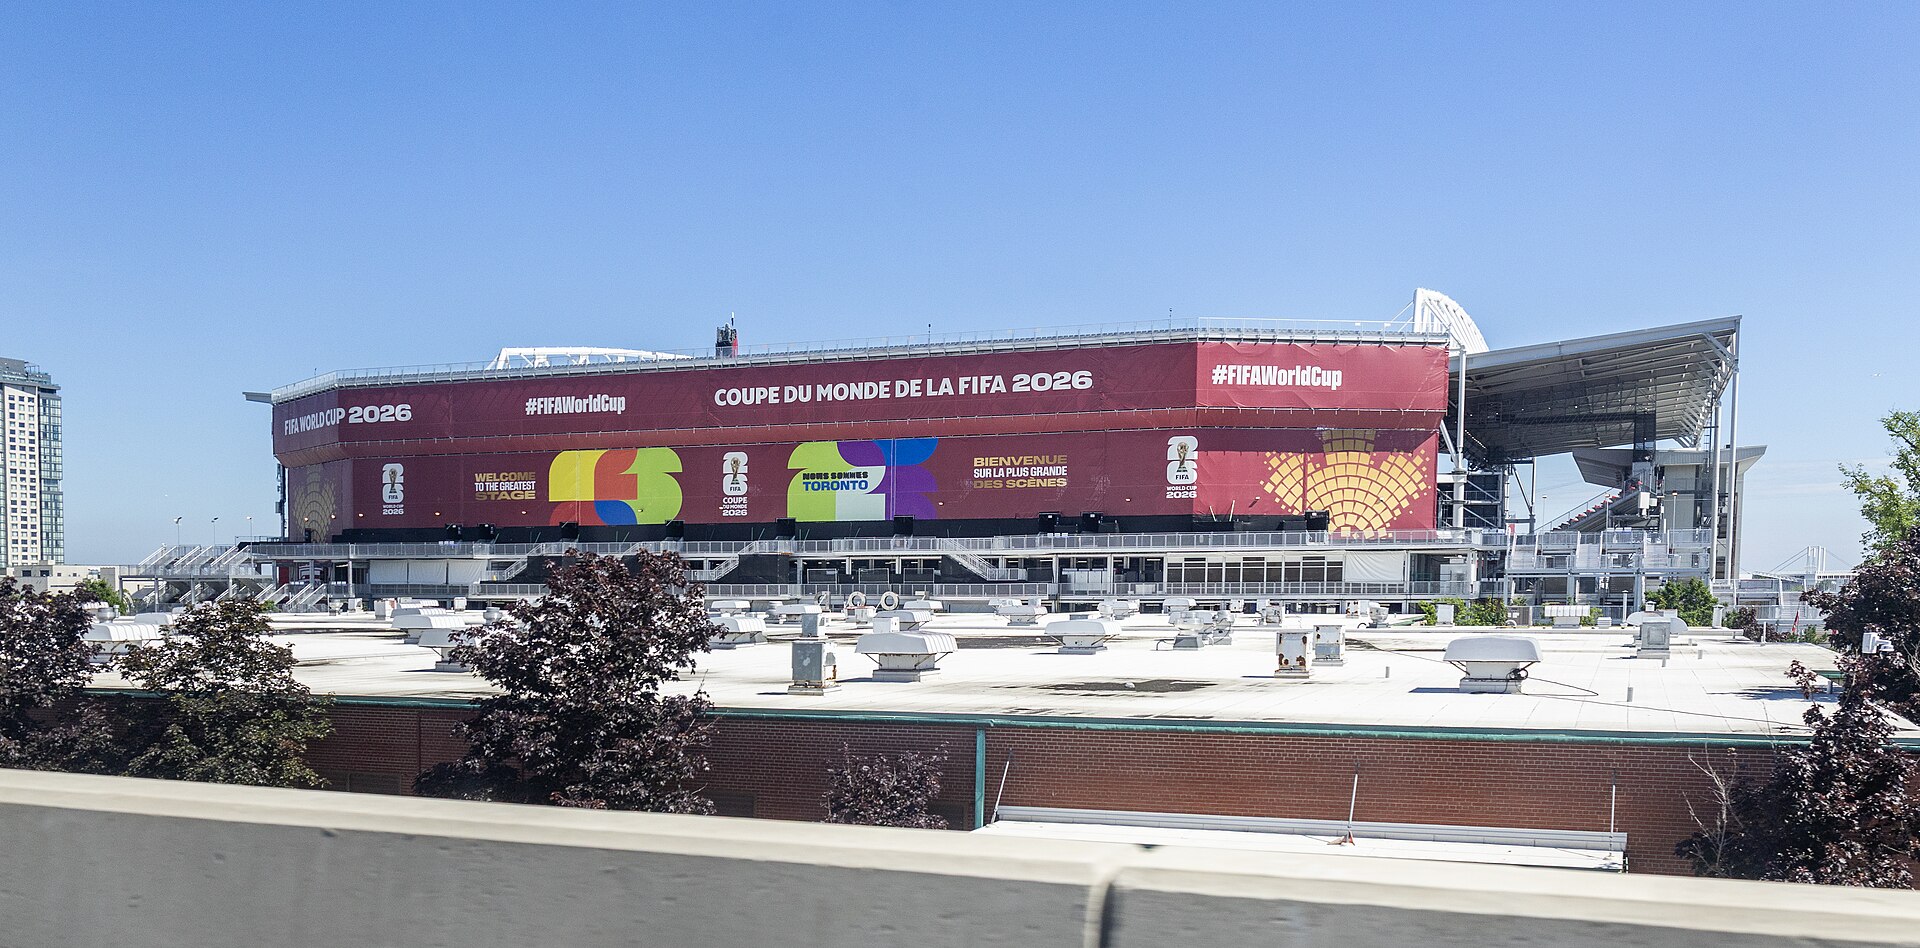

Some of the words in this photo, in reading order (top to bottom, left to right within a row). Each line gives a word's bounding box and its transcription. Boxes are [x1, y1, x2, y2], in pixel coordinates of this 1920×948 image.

[1211, 364, 1343, 391] #FIFAWorldCup
[714, 387, 780, 407] COUPE
[784, 384, 812, 404] DU
[816, 380, 891, 402] MONDE
[895, 379, 923, 398] DE
[926, 377, 955, 396] LA
[958, 375, 1007, 395] FIFA
[1012, 370, 1094, 393] 2026
[525, 393, 626, 416] #FIFAWorldCup
[284, 418, 300, 436] FIFA
[299, 411, 325, 433] WORLD
[325, 407, 346, 427] CUP
[348, 403, 413, 424] 2026
[973, 454, 1068, 467] BIENVENUE
[474, 471, 536, 482] WELCOME
[802, 472, 829, 480] NOUS
[830, 471, 869, 480] SOMMES
[973, 467, 992, 479] SUR
[993, 466, 1005, 478] LA
[1006, 465, 1030, 478] PLUS
[1030, 465, 1068, 477] GRANDE
[474, 482, 484, 492] TO
[484, 481, 499, 492] THE
[499, 480, 536, 491] GREATEST
[802, 480, 869, 491] TORONTO
[973, 479, 1004, 489] DES
[1005, 476, 1068, 489] SCÈNES
[474, 490, 536, 501] STAGE
[722, 496, 748, 504] COUPE
[1165, 490, 1198, 499] 2026
[722, 509, 748, 517] 2026
